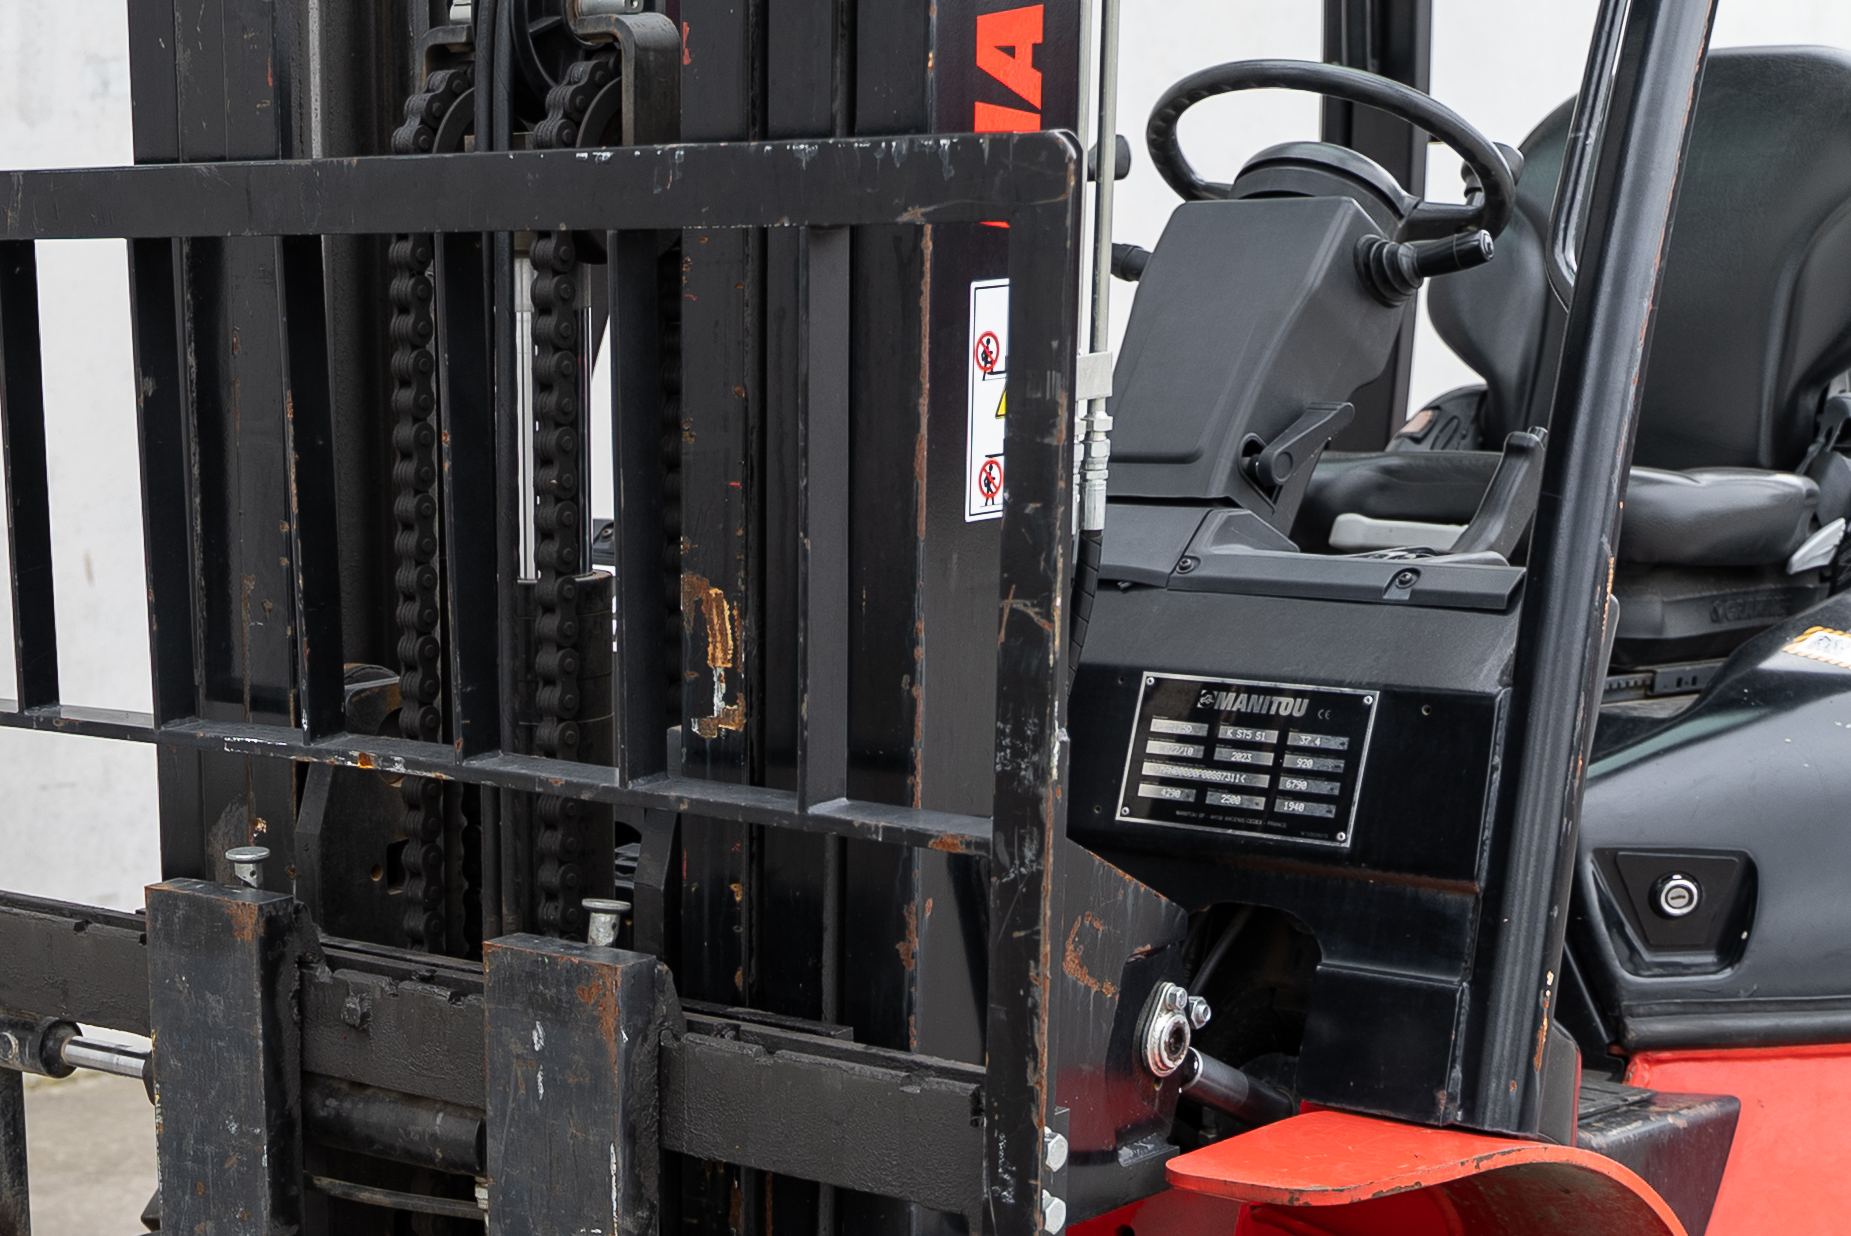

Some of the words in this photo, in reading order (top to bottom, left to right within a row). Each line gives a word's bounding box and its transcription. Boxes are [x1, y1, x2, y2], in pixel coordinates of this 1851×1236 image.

[1214, 692, 1309, 717] MANITOU
[1299, 736, 1321, 745] 37.4
[1230, 751, 1252, 762] 2023
[1295, 758, 1313, 768] 920
[1285, 779, 1308, 790] 6790
[1282, 801, 1304, 812] 1940
